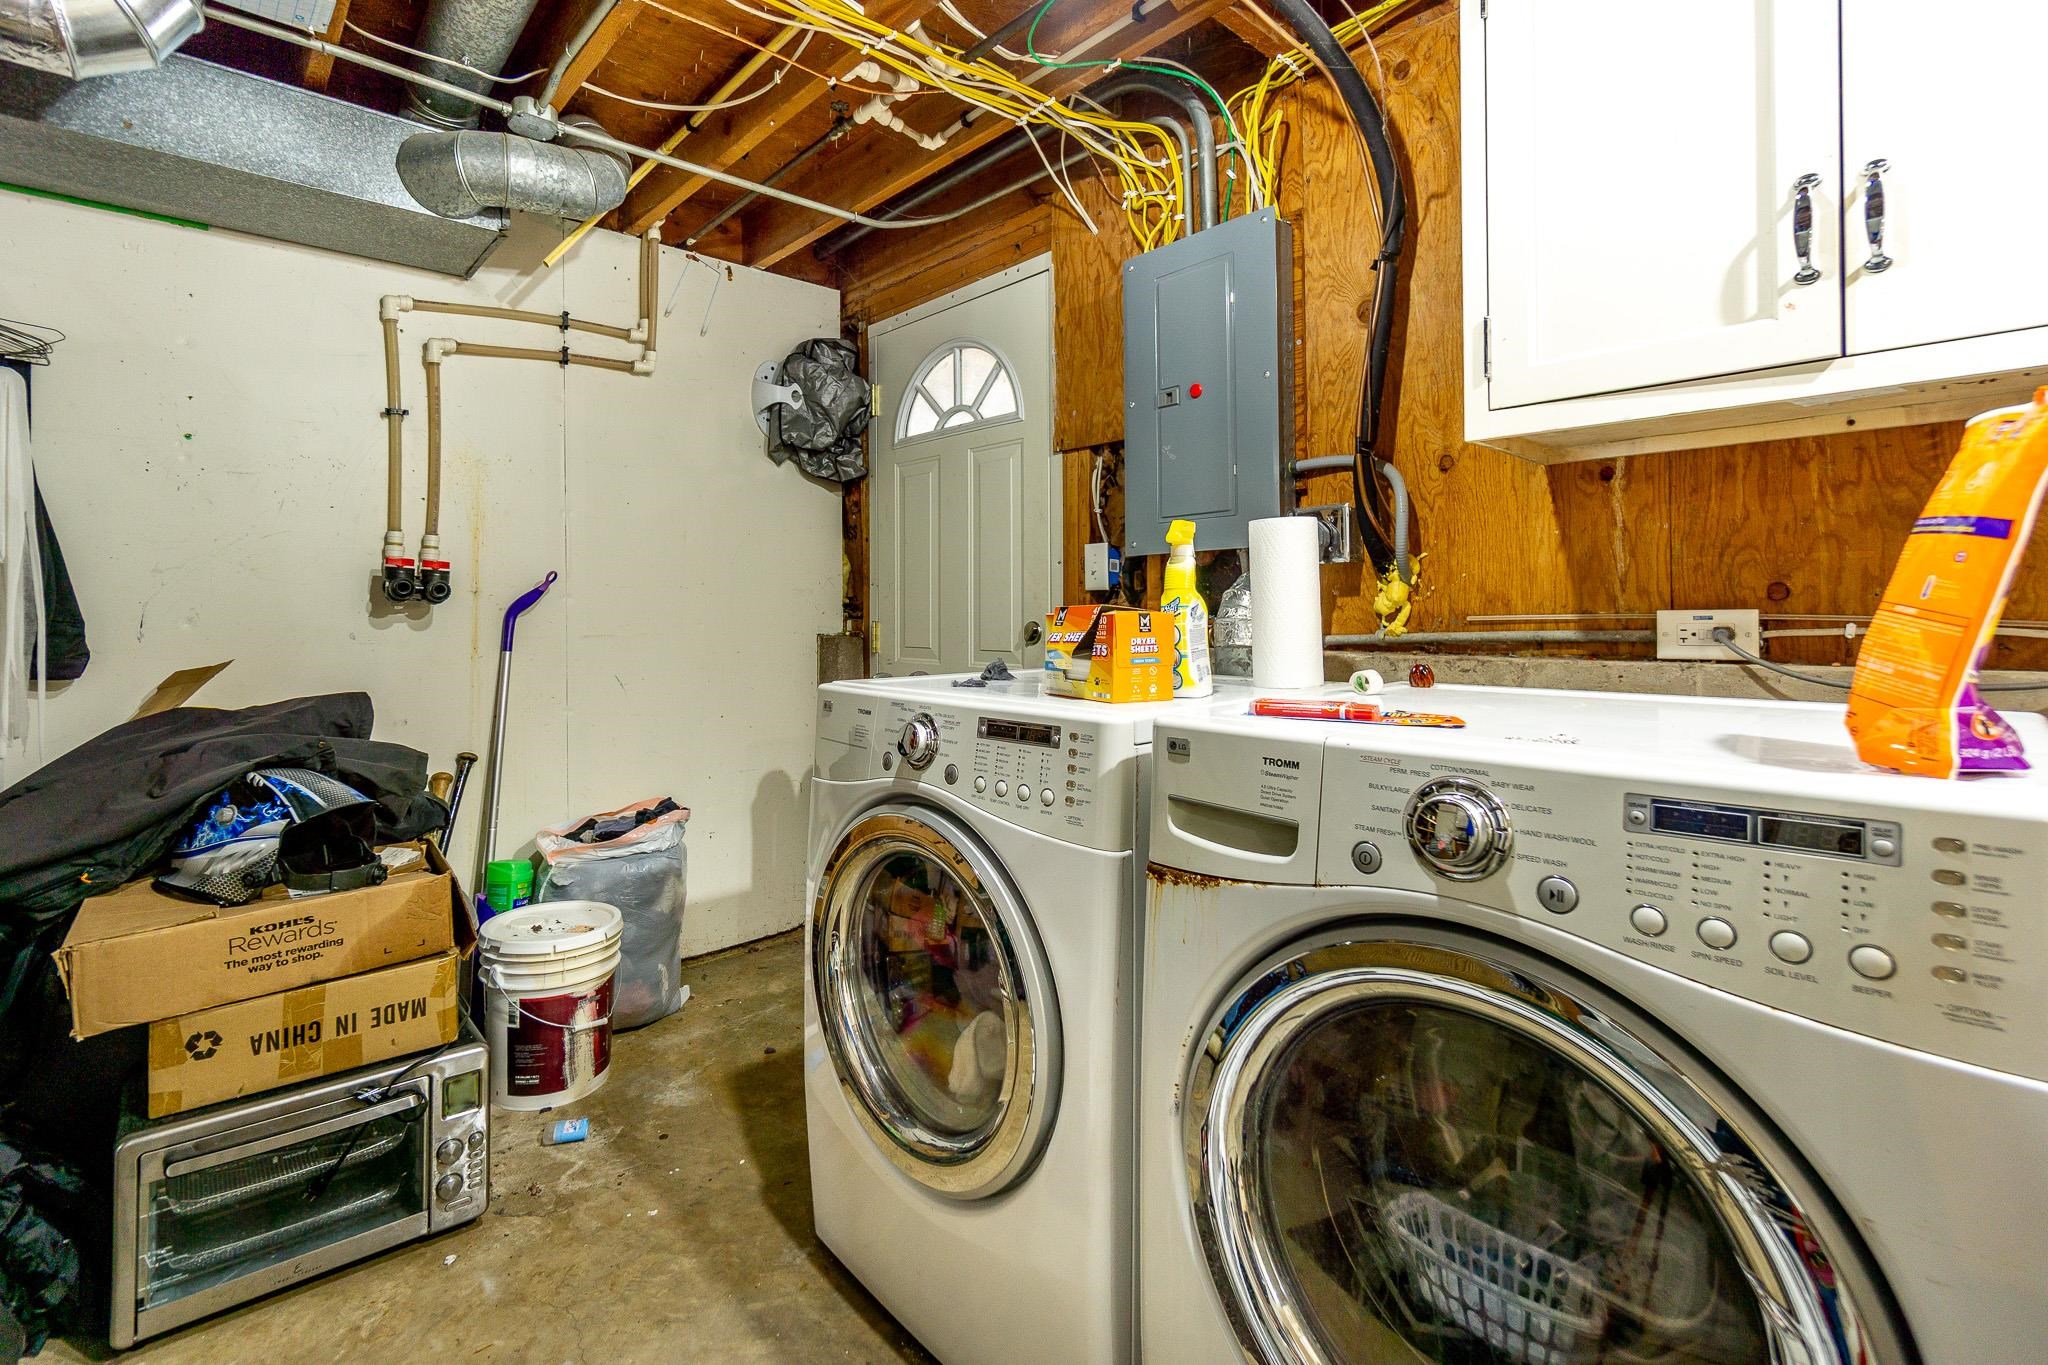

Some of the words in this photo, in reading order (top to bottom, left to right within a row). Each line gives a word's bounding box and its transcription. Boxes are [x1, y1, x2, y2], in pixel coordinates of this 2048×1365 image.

[1130, 645, 1158, 653] SHEETS
[1262, 756, 1300, 770] TROMM
[1410, 770, 1430, 778] PRESS
[1430, 764, 1490, 777] COTTON/NORMAL
[1368, 782, 1410, 794] BULKY/LARGE
[1491, 780, 1510, 788] BABY
[1512, 784, 1536, 792] WEAR
[1371, 804, 1401, 814] SANITARY
[1512, 803, 1552, 815] DELICATES
[1354, 824, 1376, 832] STEAM
[1520, 829, 1542, 838] HAND
[1517, 854, 1540, 864] SPEED
[1543, 858, 1568, 868] WASH
[1635, 854, 1670, 864] HOT/COLD
[1701, 850, 1724, 860] EXTRA
[1774, 862, 1802, 871] HEAVY
[1635, 878, 1678, 890] WARM/COLD
[1701, 876, 1732, 886] MEDIUM
[1634, 890, 1674, 901] COLD/COLD
[1701, 888, 1718, 896] LOW
[1774, 887, 1811, 899] NORMAL
[1700, 900, 1712, 908] NO
[1713, 903, 1732, 911] SPIN
[1774, 914, 1798, 922] LIGHT
[250, 916, 315, 936] KOHL'S
[228, 920, 335, 956] Rewards
[1623, 936, 1676, 952] WASH/RINSE
[224, 959, 248, 970] The
[252, 950, 282, 964] most
[285, 938, 344, 956] rewarding
[1691, 950, 1712, 962] SPIN
[1714, 956, 1744, 968] SPEED
[248, 961, 272, 974] way
[276, 958, 289, 967] to
[292, 951, 324, 964] shop.
[1764, 966, 1786, 978] SOIL
[1788, 972, 1818, 984] LEVEL
[1852, 984, 1893, 999] BEEPER
[370, 996, 427, 1028] MADE
[1946, 1004, 1992, 1018] OPTION
[335, 1012, 357, 1037] IN
[250, 1020, 322, 1056] CHINA
